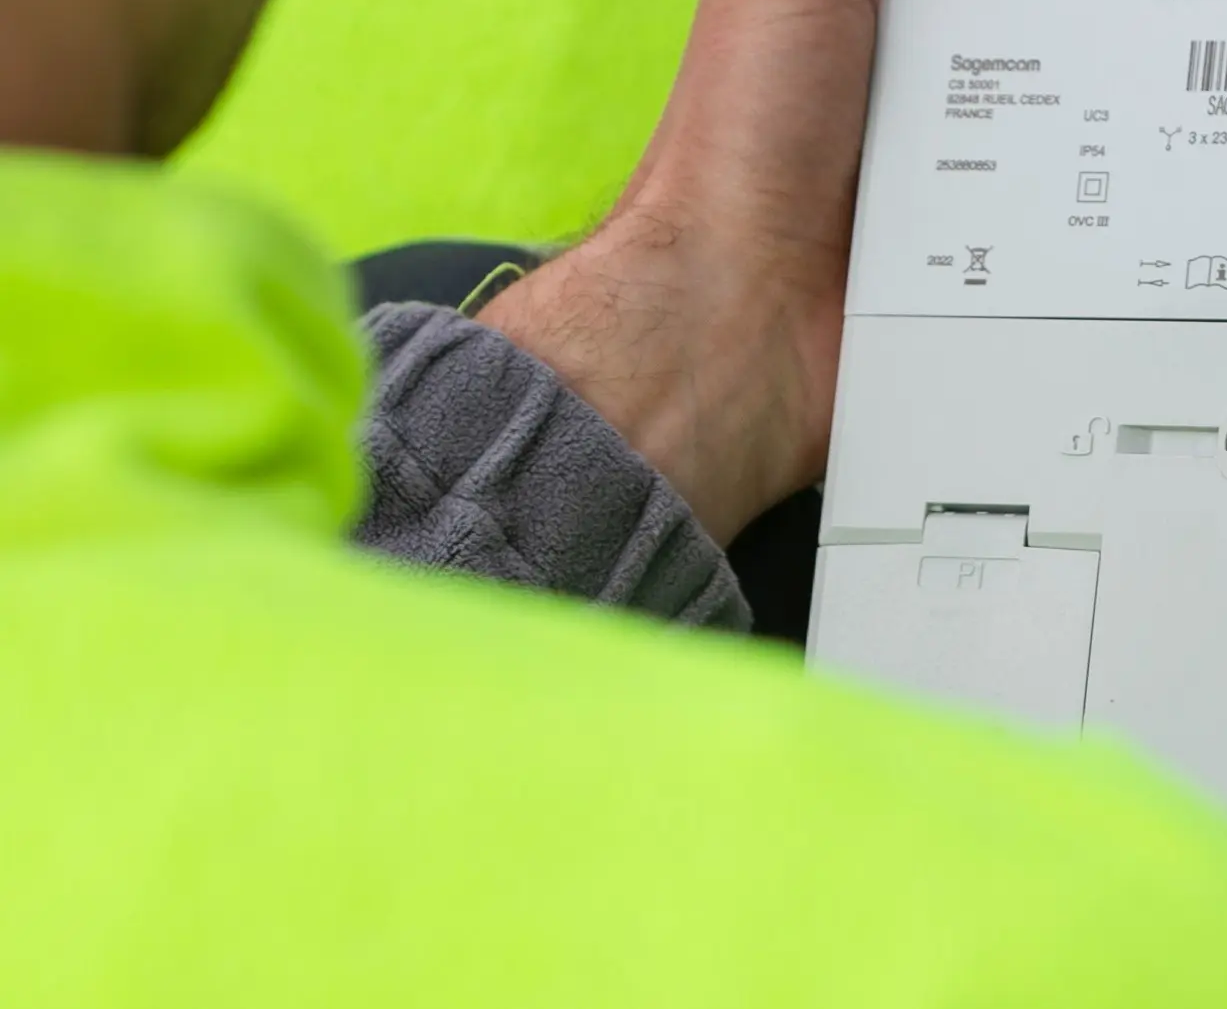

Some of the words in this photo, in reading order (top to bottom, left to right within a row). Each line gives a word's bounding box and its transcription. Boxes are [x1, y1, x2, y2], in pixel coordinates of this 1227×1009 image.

[1018, 93, 1061, 106] CEDEX
[944, 107, 994, 120] FRANCE
[1083, 109, 1110, 123] UC3
[1078, 144, 1106, 158] IP54
[1067, 215, 1095, 228] OVC
